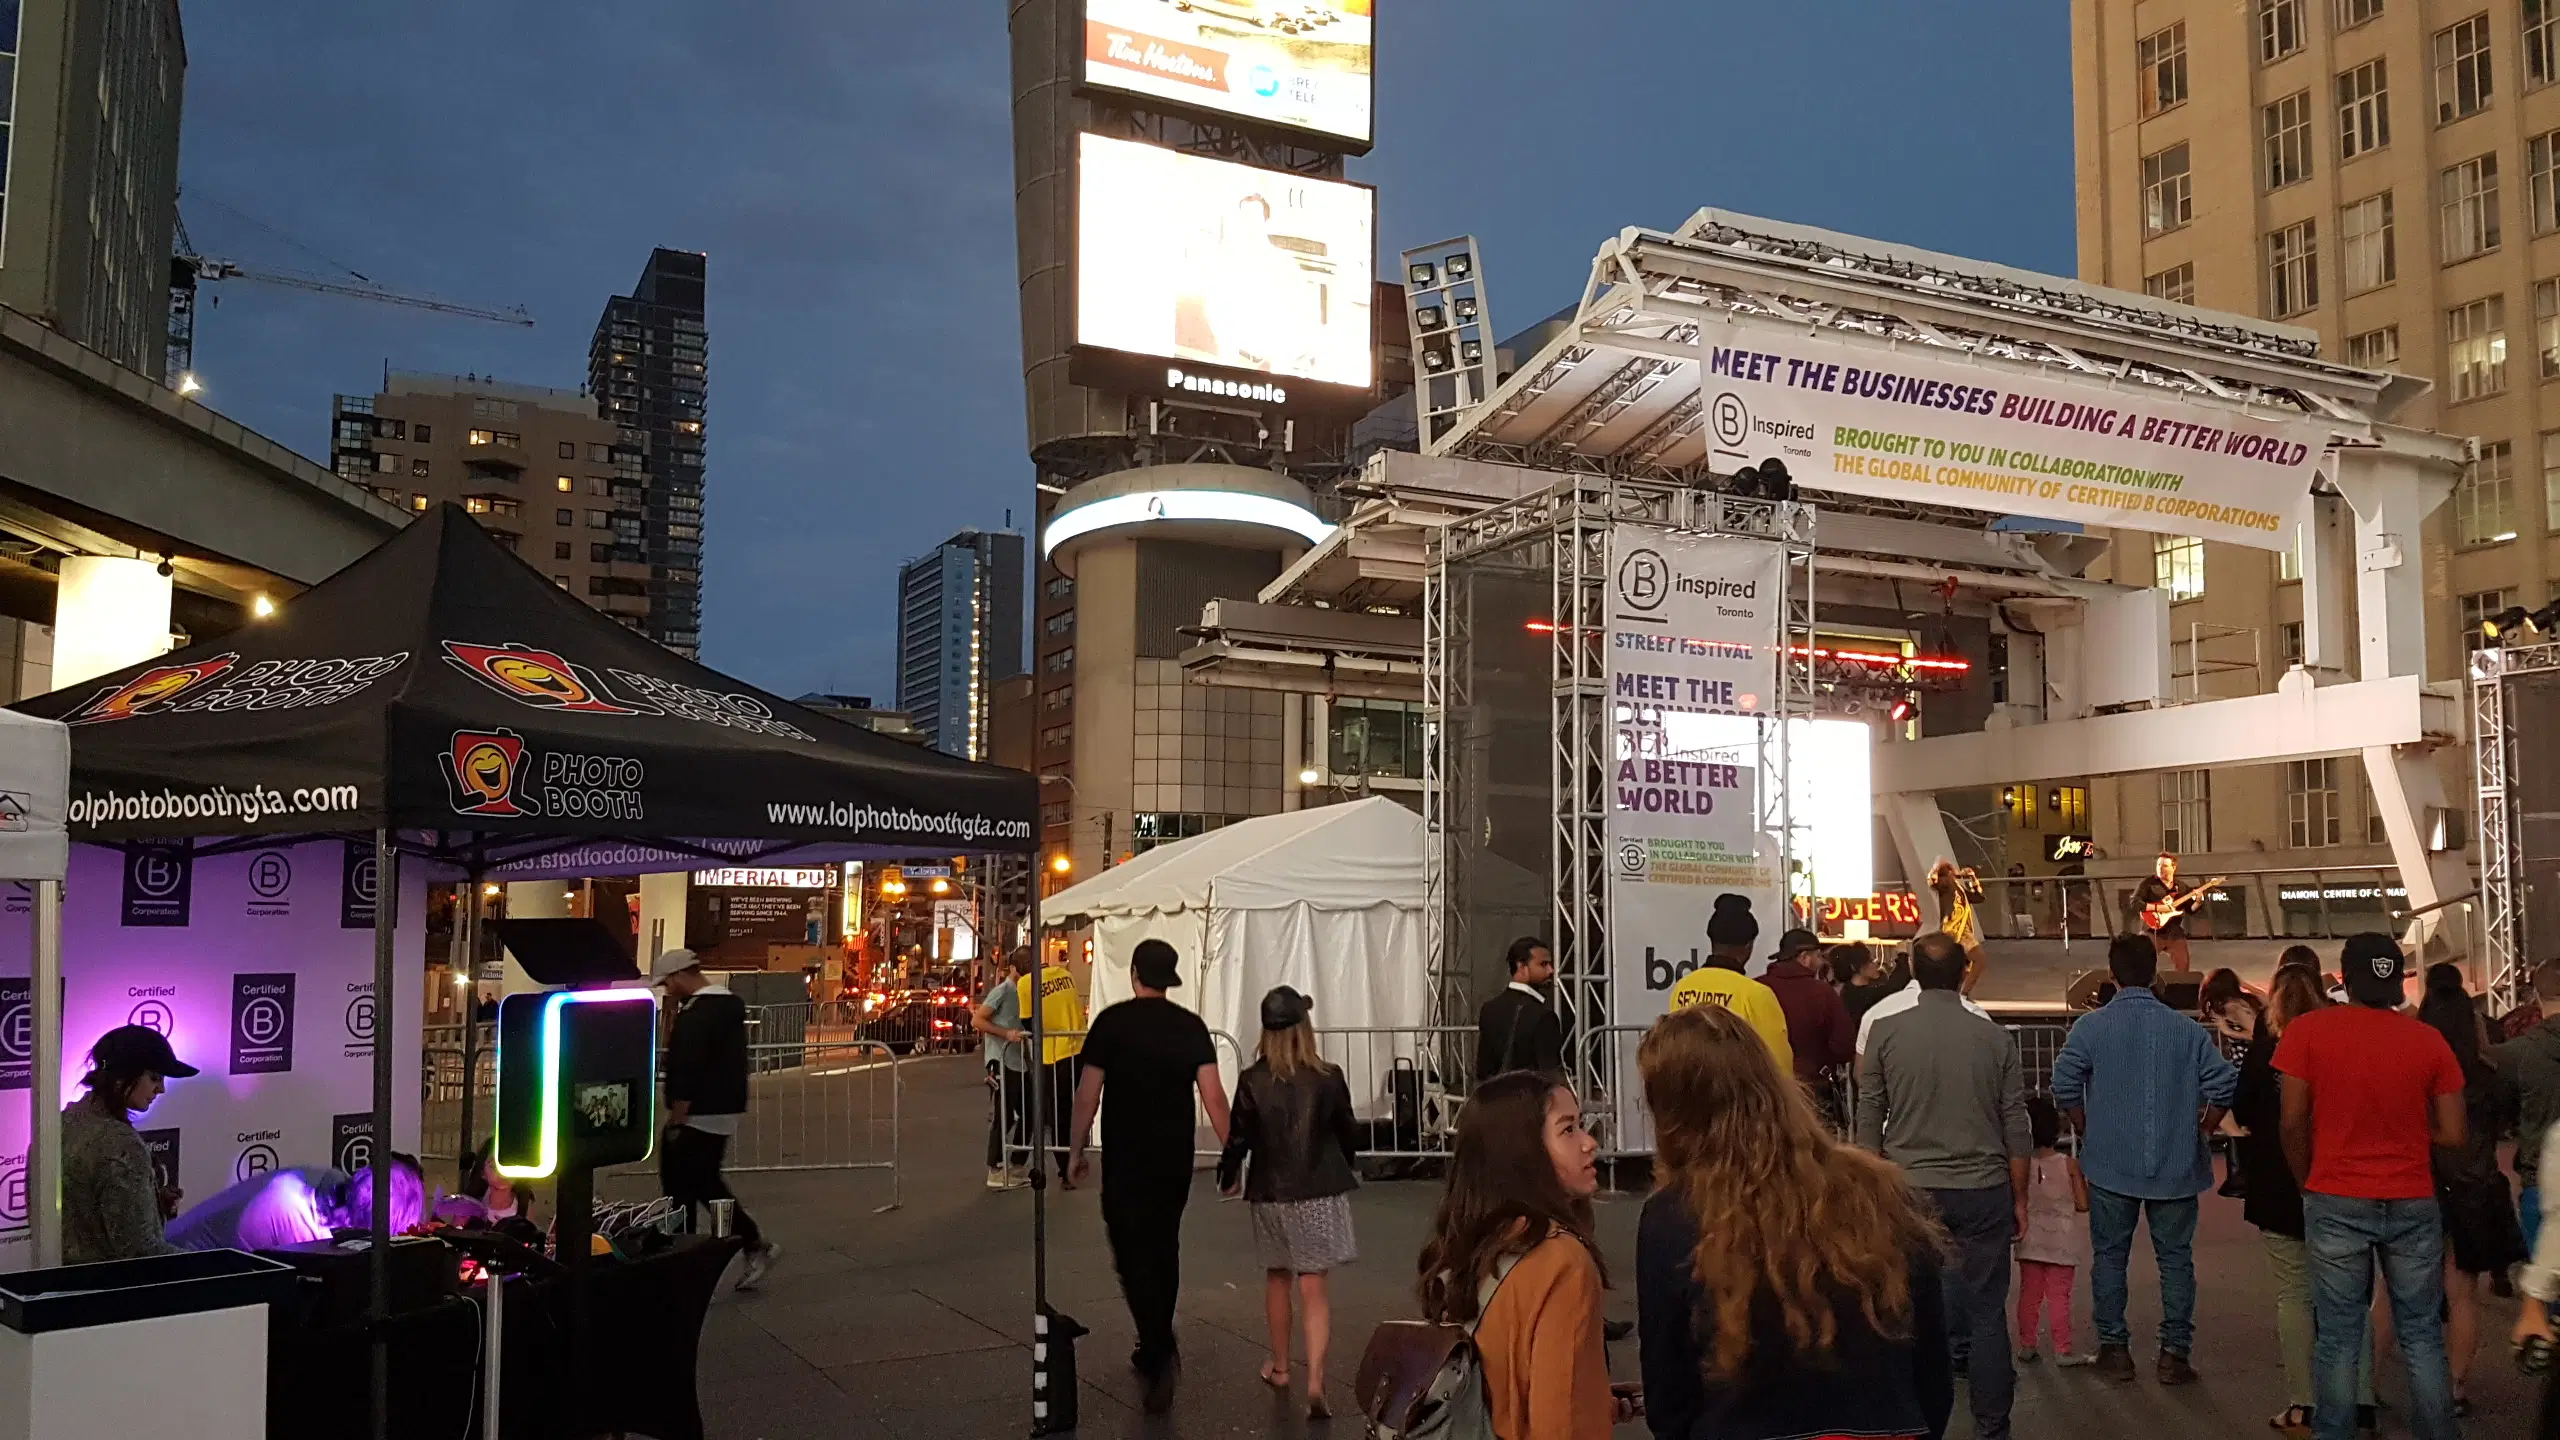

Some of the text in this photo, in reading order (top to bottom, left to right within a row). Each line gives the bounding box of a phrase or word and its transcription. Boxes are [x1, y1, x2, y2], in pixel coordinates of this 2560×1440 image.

[1167, 368, 1286, 404] Panasonic
[1711, 346, 2308, 467] MEET THE BUSINESSES BUILDING A BETTER WORLD
[1783, 445, 1812, 457] Toronto
[1833, 426, 2184, 492] BROUGHT TO YOU IN COLLABORATION WITH
[1833, 452, 2280, 533] THE GLOBAL COMMUNITY OF CERTIFIED B CORPORATIONS
[1716, 606, 1754, 618] Toronto
[1615, 632, 1754, 660] STREET FESTIVAL
[223, 651, 409, 688] PHOTO
[172, 681, 372, 712] BOOTH
[1616, 672, 1734, 706] MEET THE
[544, 753, 644, 788] PHOTO
[1617, 758, 1739, 789] A BETTER
[69, 784, 359, 830] olphotoboothgta.com
[544, 786, 644, 820] BOOTH
[1617, 787, 1713, 816] WORLD
[767, 801, 1031, 841] www.lolphotoboothgta.com
[1648, 838, 1725, 850] BROUGHT TO YOU
[1650, 850, 1660, 860] IN
[1661, 850, 1734, 864] COLLABORATION
[696, 869, 836, 887] IMPERIAL PUB
[2323, 889, 2357, 899] CENTRE
[2359, 889, 2372, 898] OF
[132, 907, 180, 917] Corporation
[246, 907, 290, 917] Corporation
[128, 986, 176, 998] Certified
[242, 985, 286, 996] Certified
[239, 1054, 284, 1065] Corporation
[237, 1129, 281, 1143] Certified
